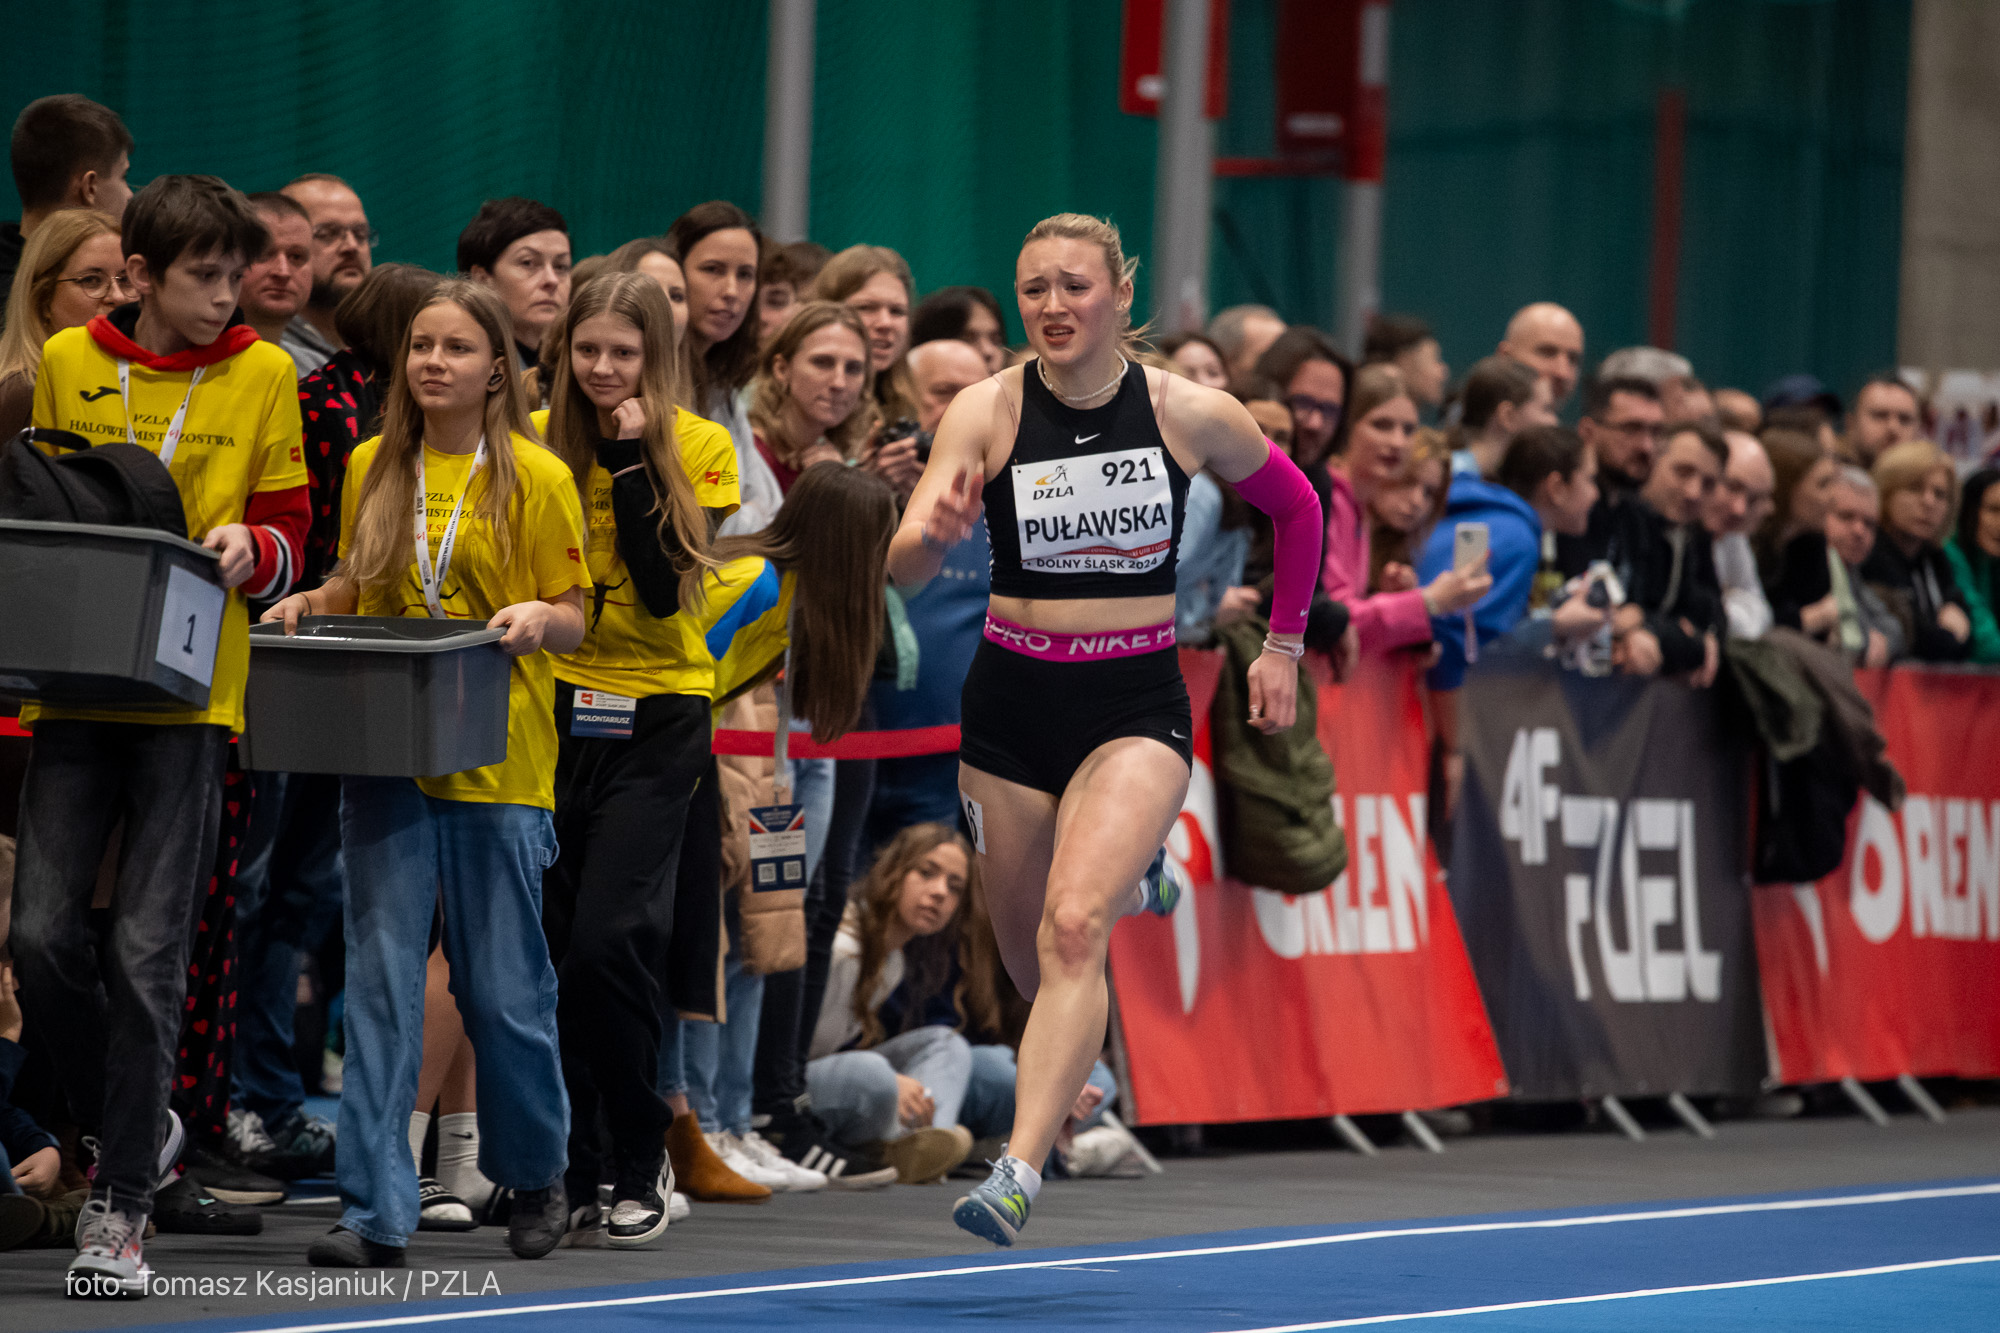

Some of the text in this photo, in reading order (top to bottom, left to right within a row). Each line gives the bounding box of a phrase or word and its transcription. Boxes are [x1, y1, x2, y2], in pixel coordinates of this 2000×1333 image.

[133, 413, 171, 426] PZLA
[69, 420, 236, 447] HALOWE MISTZOSTWA
[1101, 457, 1156, 487] 921
[1033, 486, 1074, 500] DZLA
[1024, 502, 1167, 544] PUŁAWSKA
[1036, 556, 1157, 571] DOLNY ŚLĄSK 2024
[183, 613, 196, 655] 1
[1068, 633, 1151, 655] NIKE
[576, 714, 630, 724] WOLONTARIUSZ
[1501, 726, 1723, 1002] 4F FUEL
